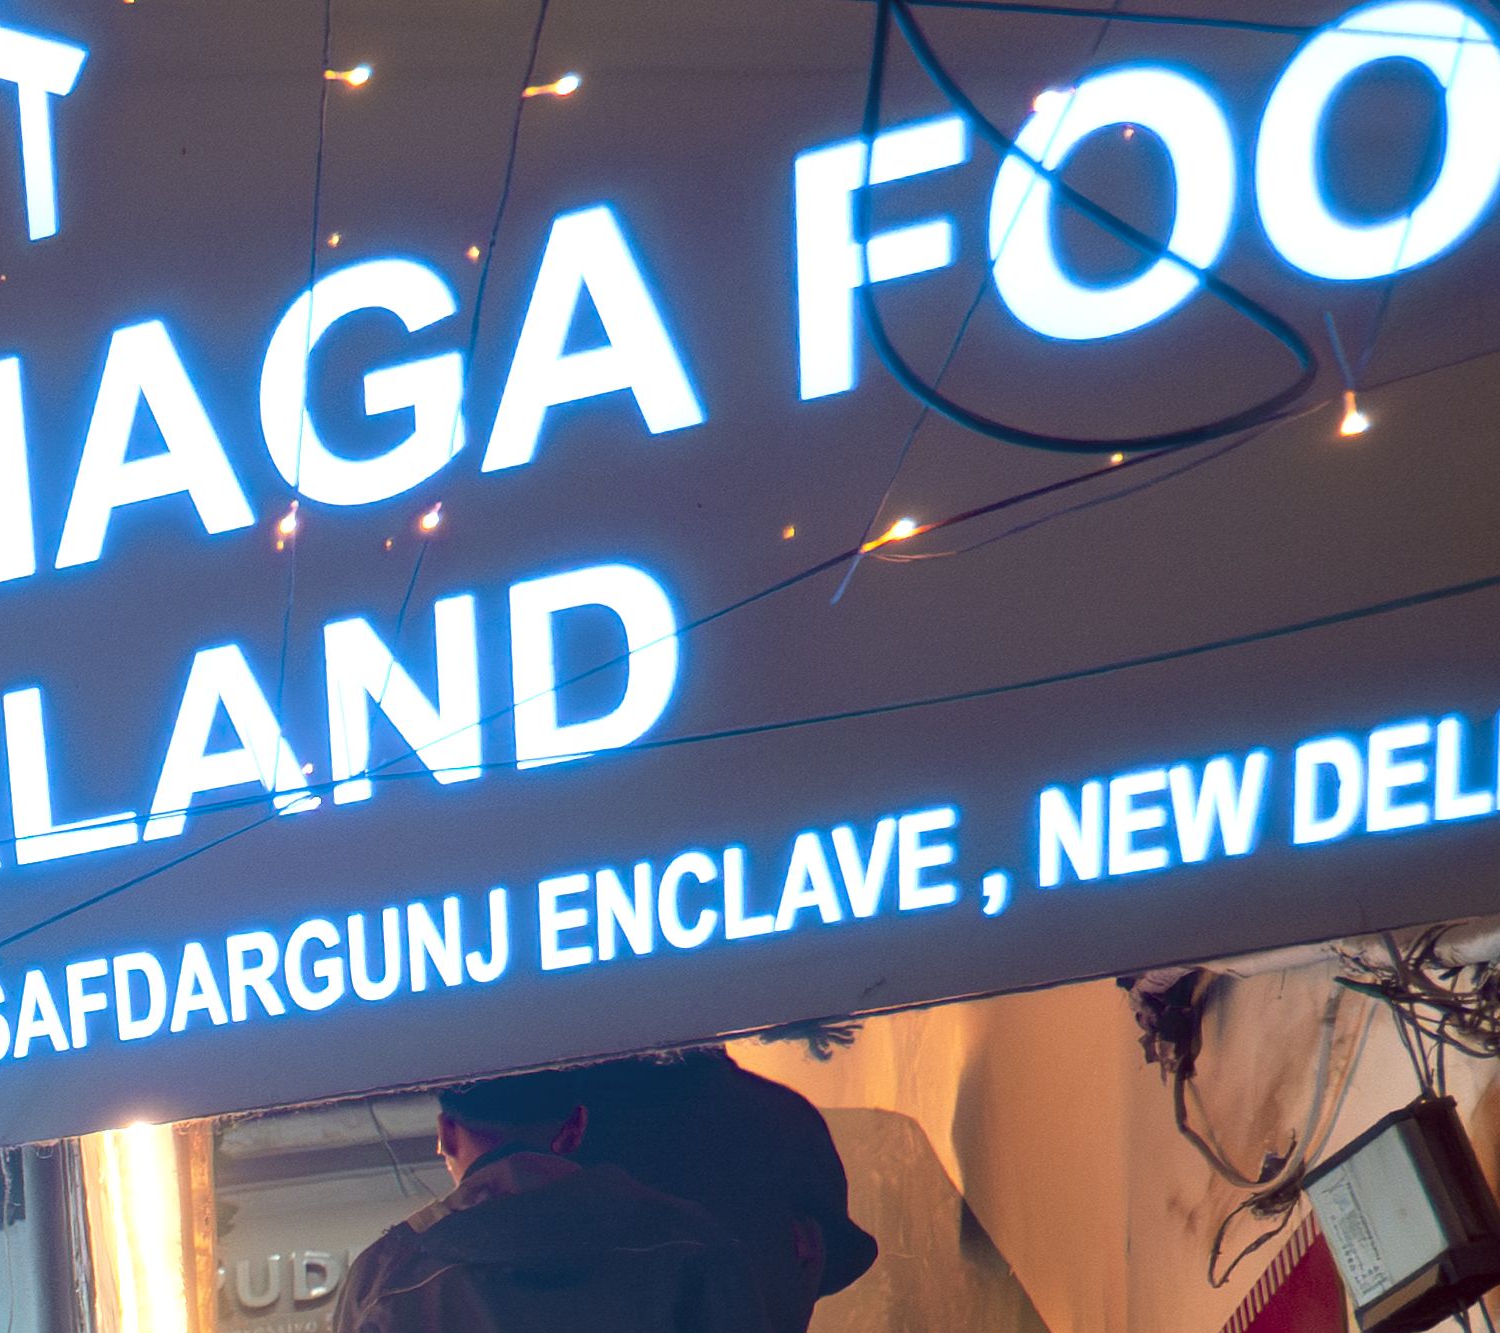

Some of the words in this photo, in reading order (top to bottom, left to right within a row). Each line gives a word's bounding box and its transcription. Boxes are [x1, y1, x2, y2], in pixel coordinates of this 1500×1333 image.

[537, 808, 958, 973] ENCLAVE
[1039, 748, 1270, 889] NEW
[1293, 714, 1500, 846] DEL
